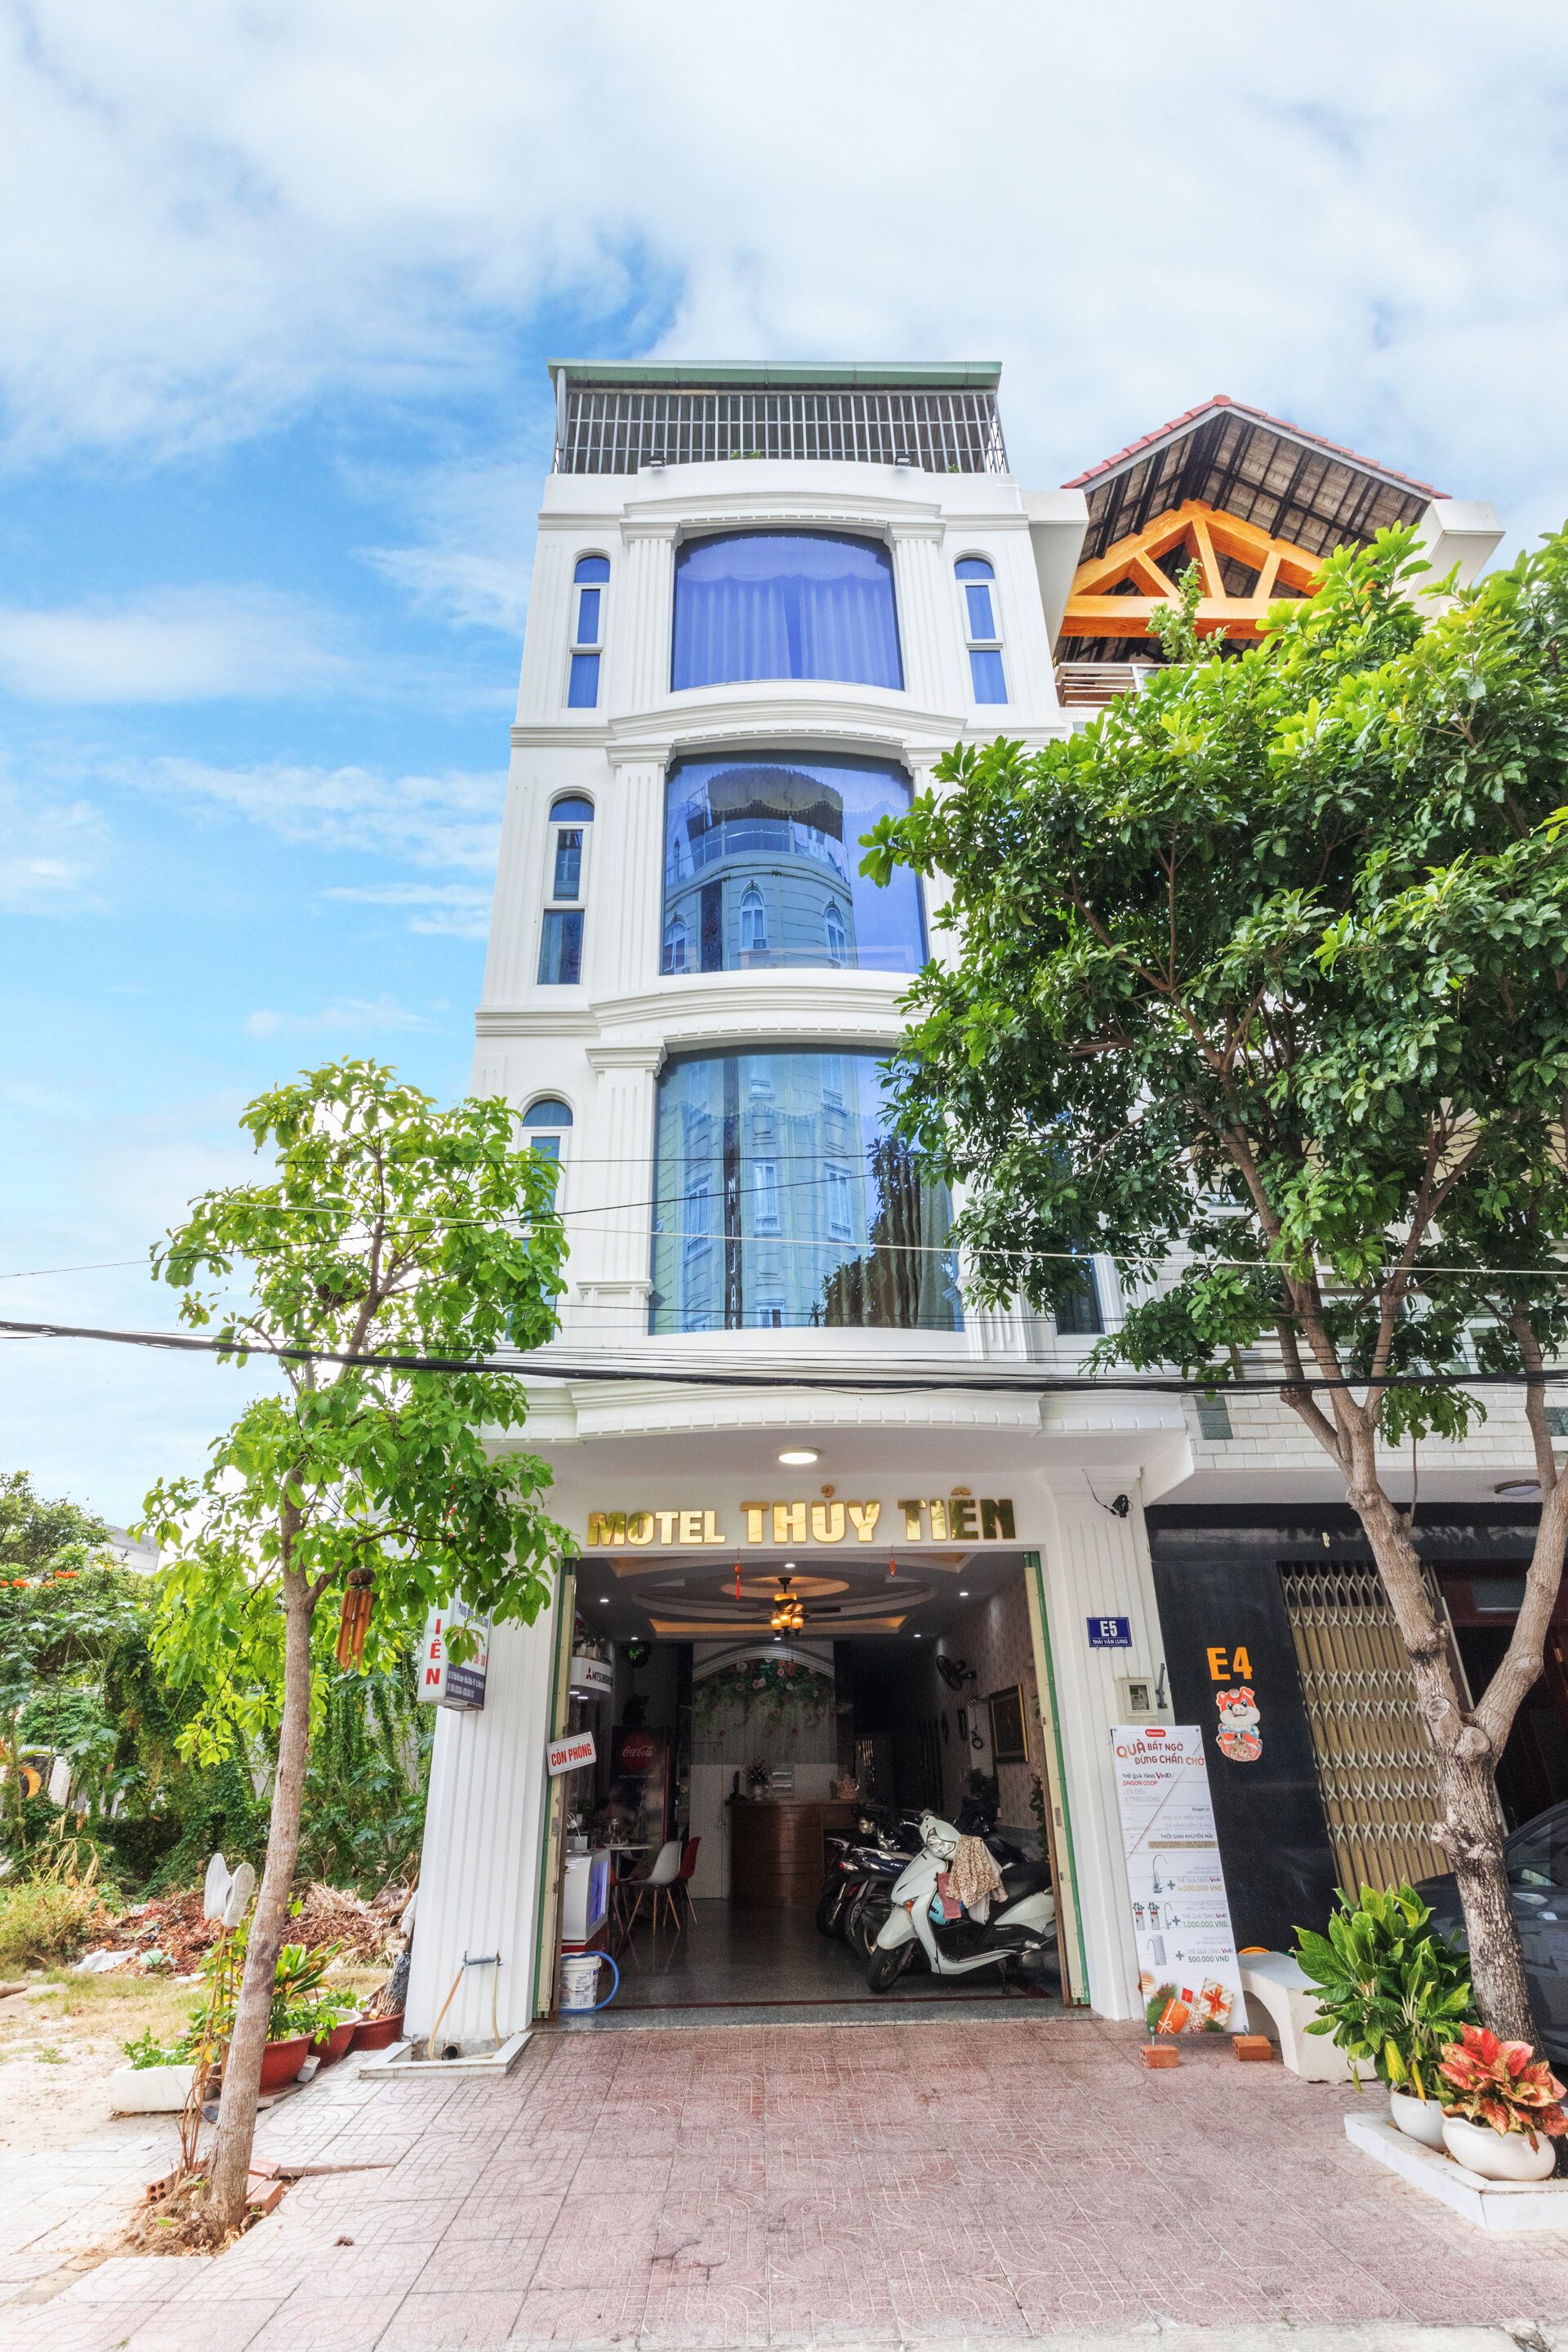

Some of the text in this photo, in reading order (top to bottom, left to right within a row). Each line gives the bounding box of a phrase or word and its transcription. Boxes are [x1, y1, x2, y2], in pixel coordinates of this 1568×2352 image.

[587, 1485, 1017, 1547] MOTEL THỦY TIÊN
[1099, 1620, 1118, 1637] E5
[425, 1619, 442, 1686] IÊN
[1206, 1646, 1253, 1680] E4
[550, 1742, 593, 1767] CÒN PHÒNG
[1116, 1739, 1183, 1758] QUÀ BẤT NGỜ
[1187, 1955, 1214, 1963] 500.000
